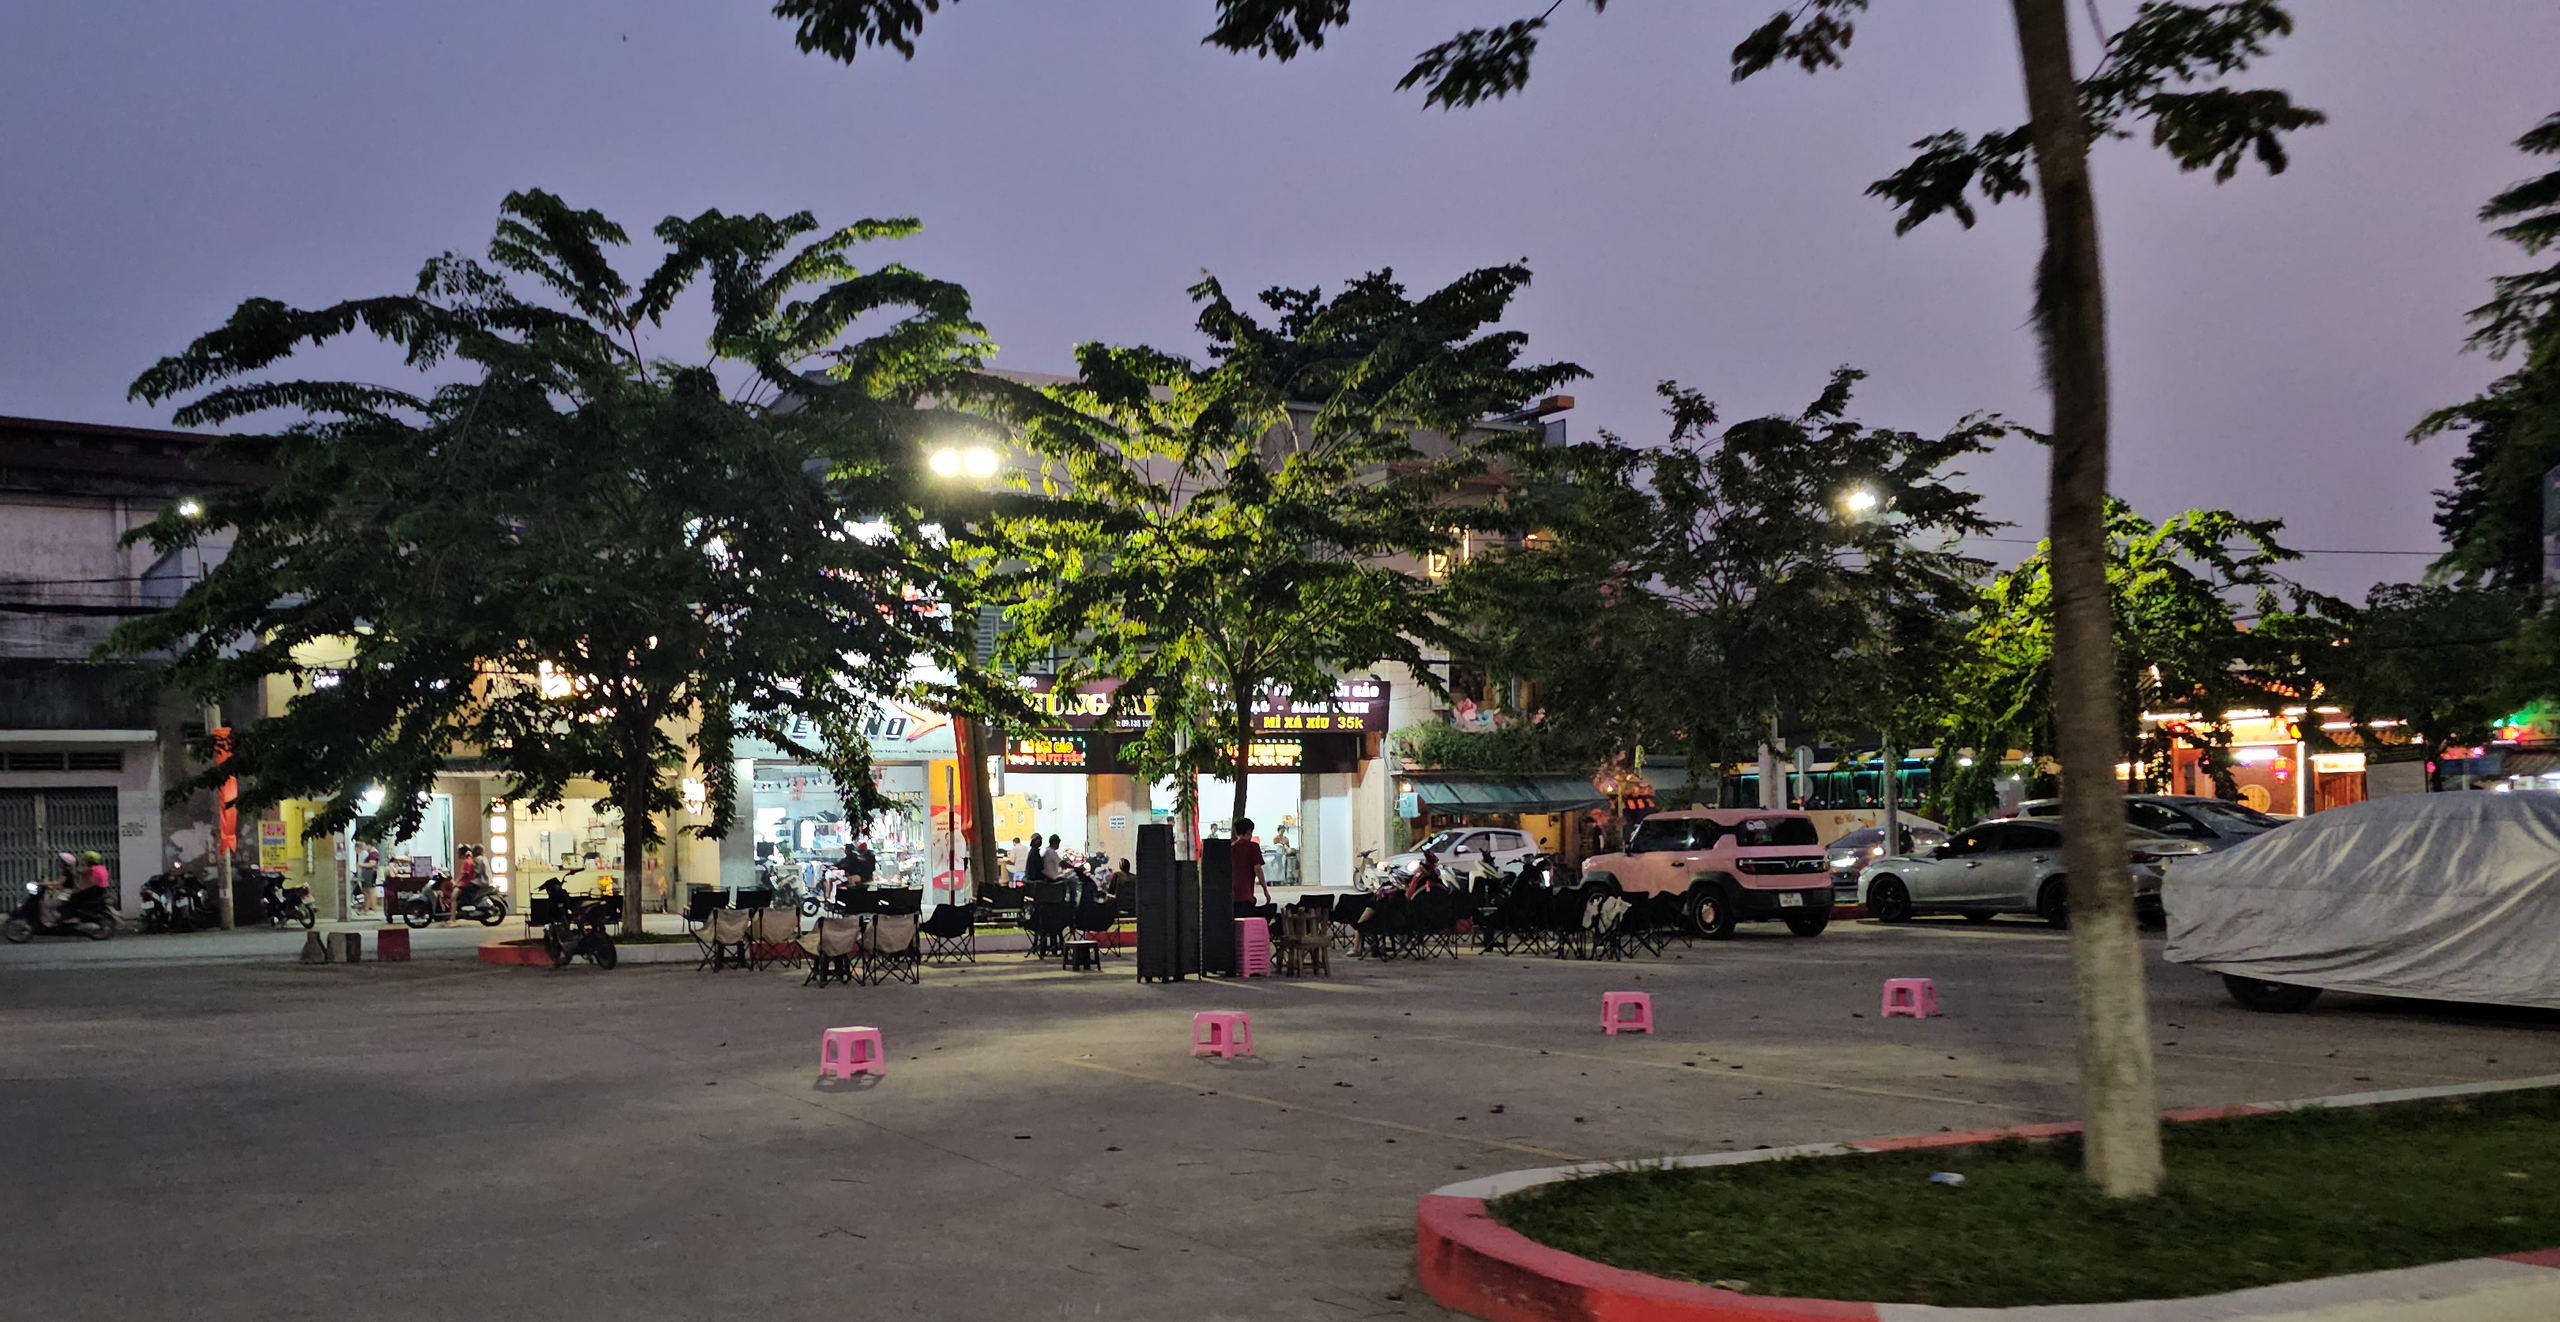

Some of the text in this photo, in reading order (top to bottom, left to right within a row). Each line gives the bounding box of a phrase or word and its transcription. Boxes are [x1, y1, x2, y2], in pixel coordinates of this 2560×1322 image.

[1263, 714, 1281, 728] MÌ
[1284, 714, 1303, 728] XÁ
[1306, 714, 1330, 729] XÍU
[1337, 716, 1364, 729] 35k
